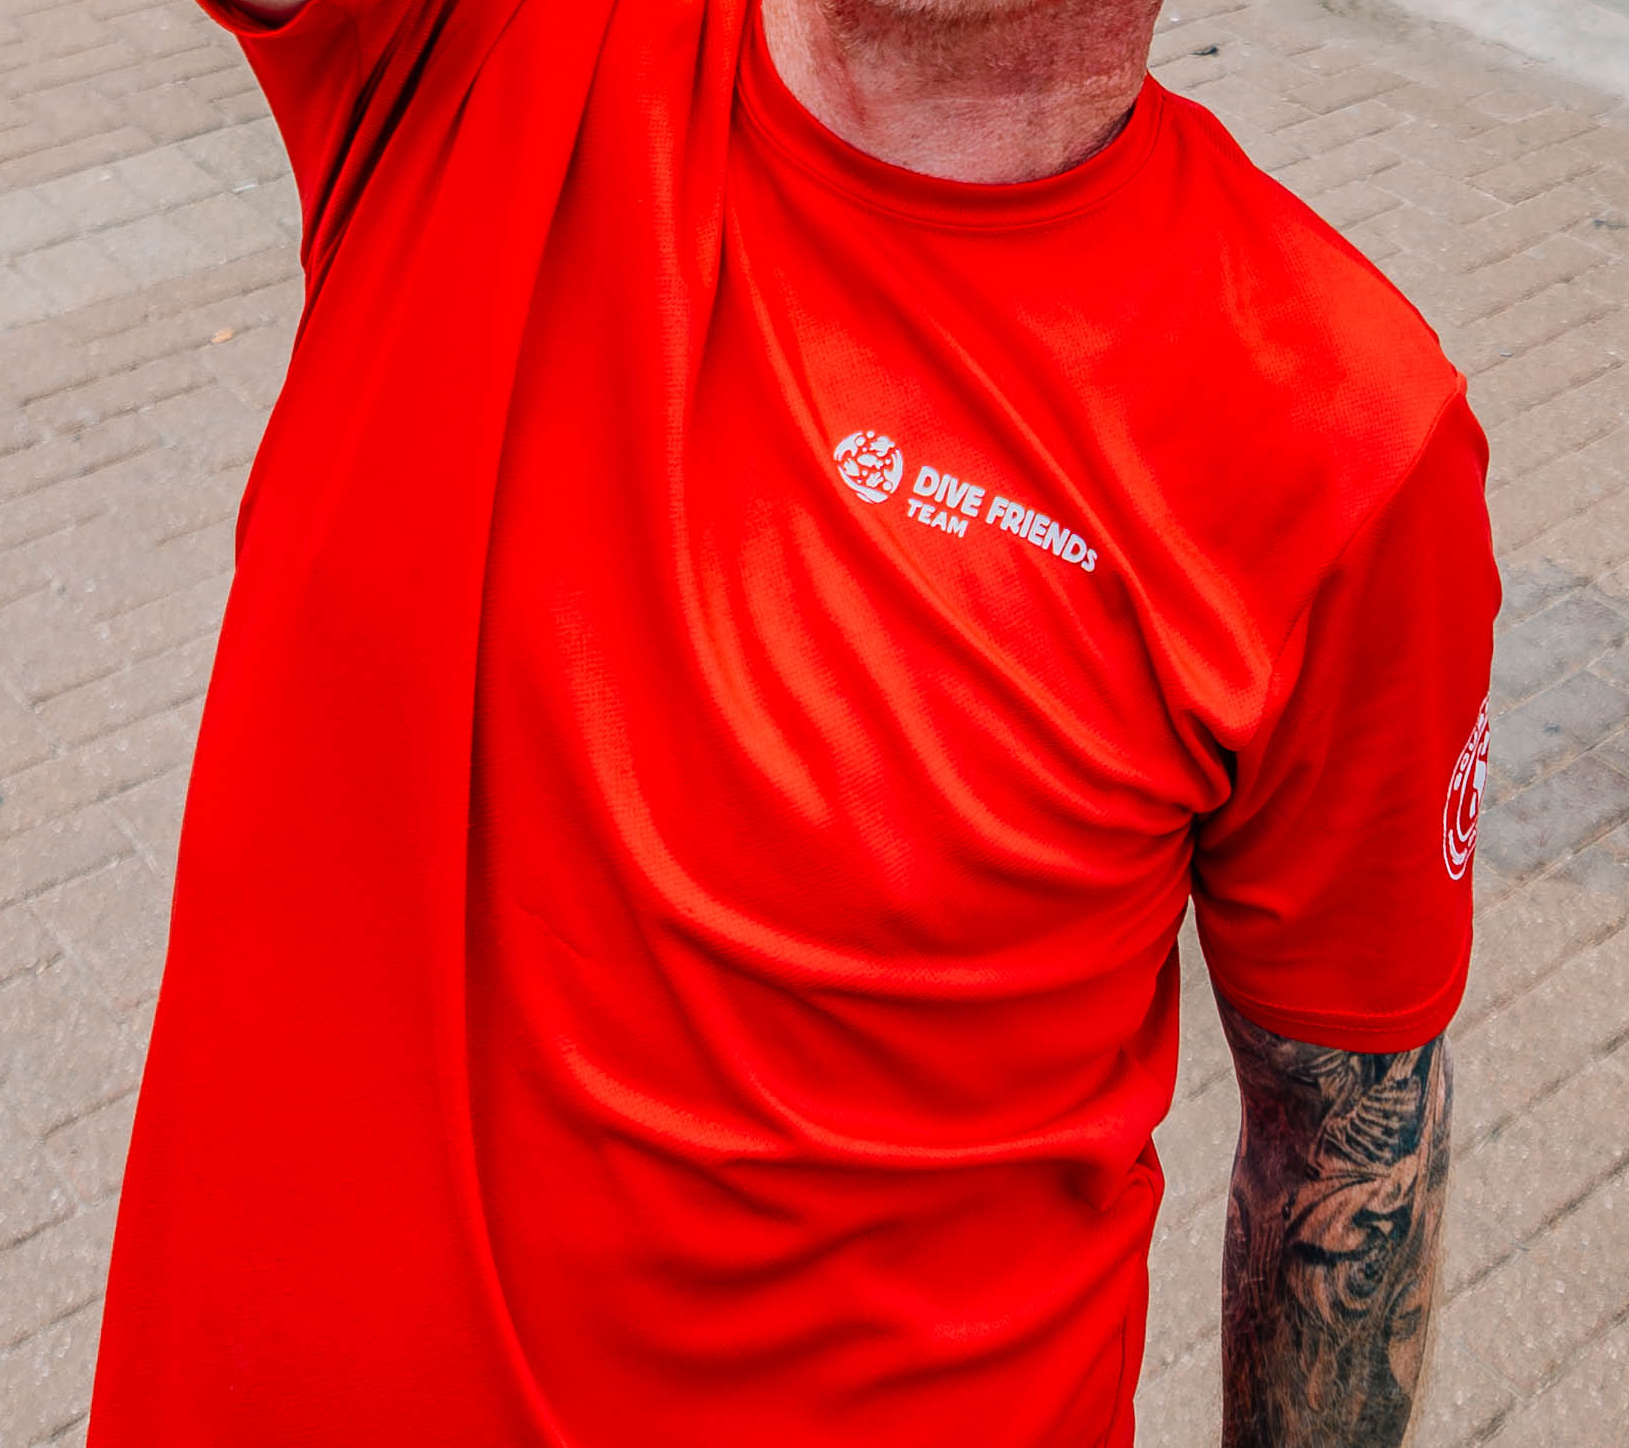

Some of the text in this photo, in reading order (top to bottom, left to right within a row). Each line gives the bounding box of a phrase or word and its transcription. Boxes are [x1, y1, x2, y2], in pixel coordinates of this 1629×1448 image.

[907, 498, 969, 538] TEAM
[912, 465, 1098, 572] DIVE FRIENDS
